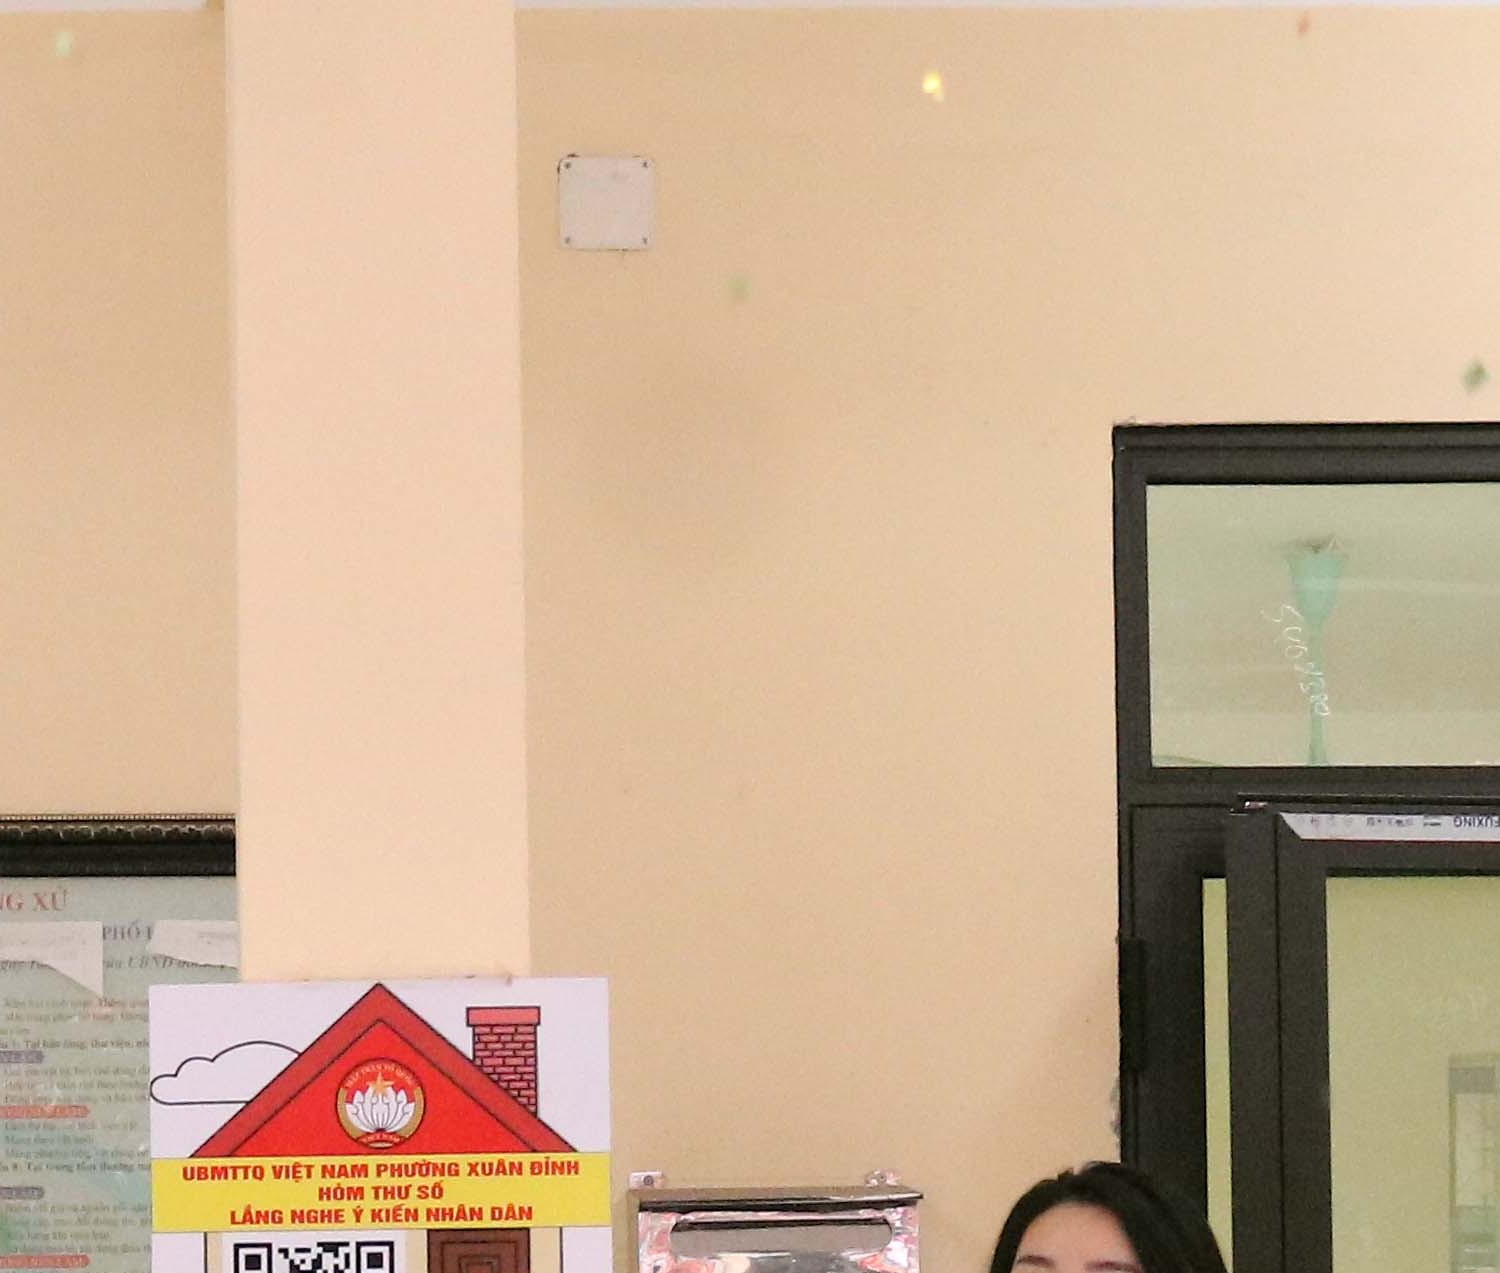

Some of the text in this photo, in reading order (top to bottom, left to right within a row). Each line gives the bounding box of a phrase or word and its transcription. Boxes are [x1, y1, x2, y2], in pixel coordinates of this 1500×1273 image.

[182, 1164, 265, 1181] UBMTTQ
[271, 1161, 315, 1183] VIỆT
[321, 1163, 369, 1179] NAM
[375, 1160, 460, 1178] PHƯỜNG
[467, 1158, 523, 1177] XUÂN
[318, 1180, 445, 1201] HÒM THƯ SỐ
[290, 1208, 345, 1224] NGHE
[352, 1205, 364, 1223] Ý
[371, 1203, 419, 1223] KIẾN
[426, 1203, 483, 1221] NHÂN
[490, 1203, 533, 1221] DÂN
